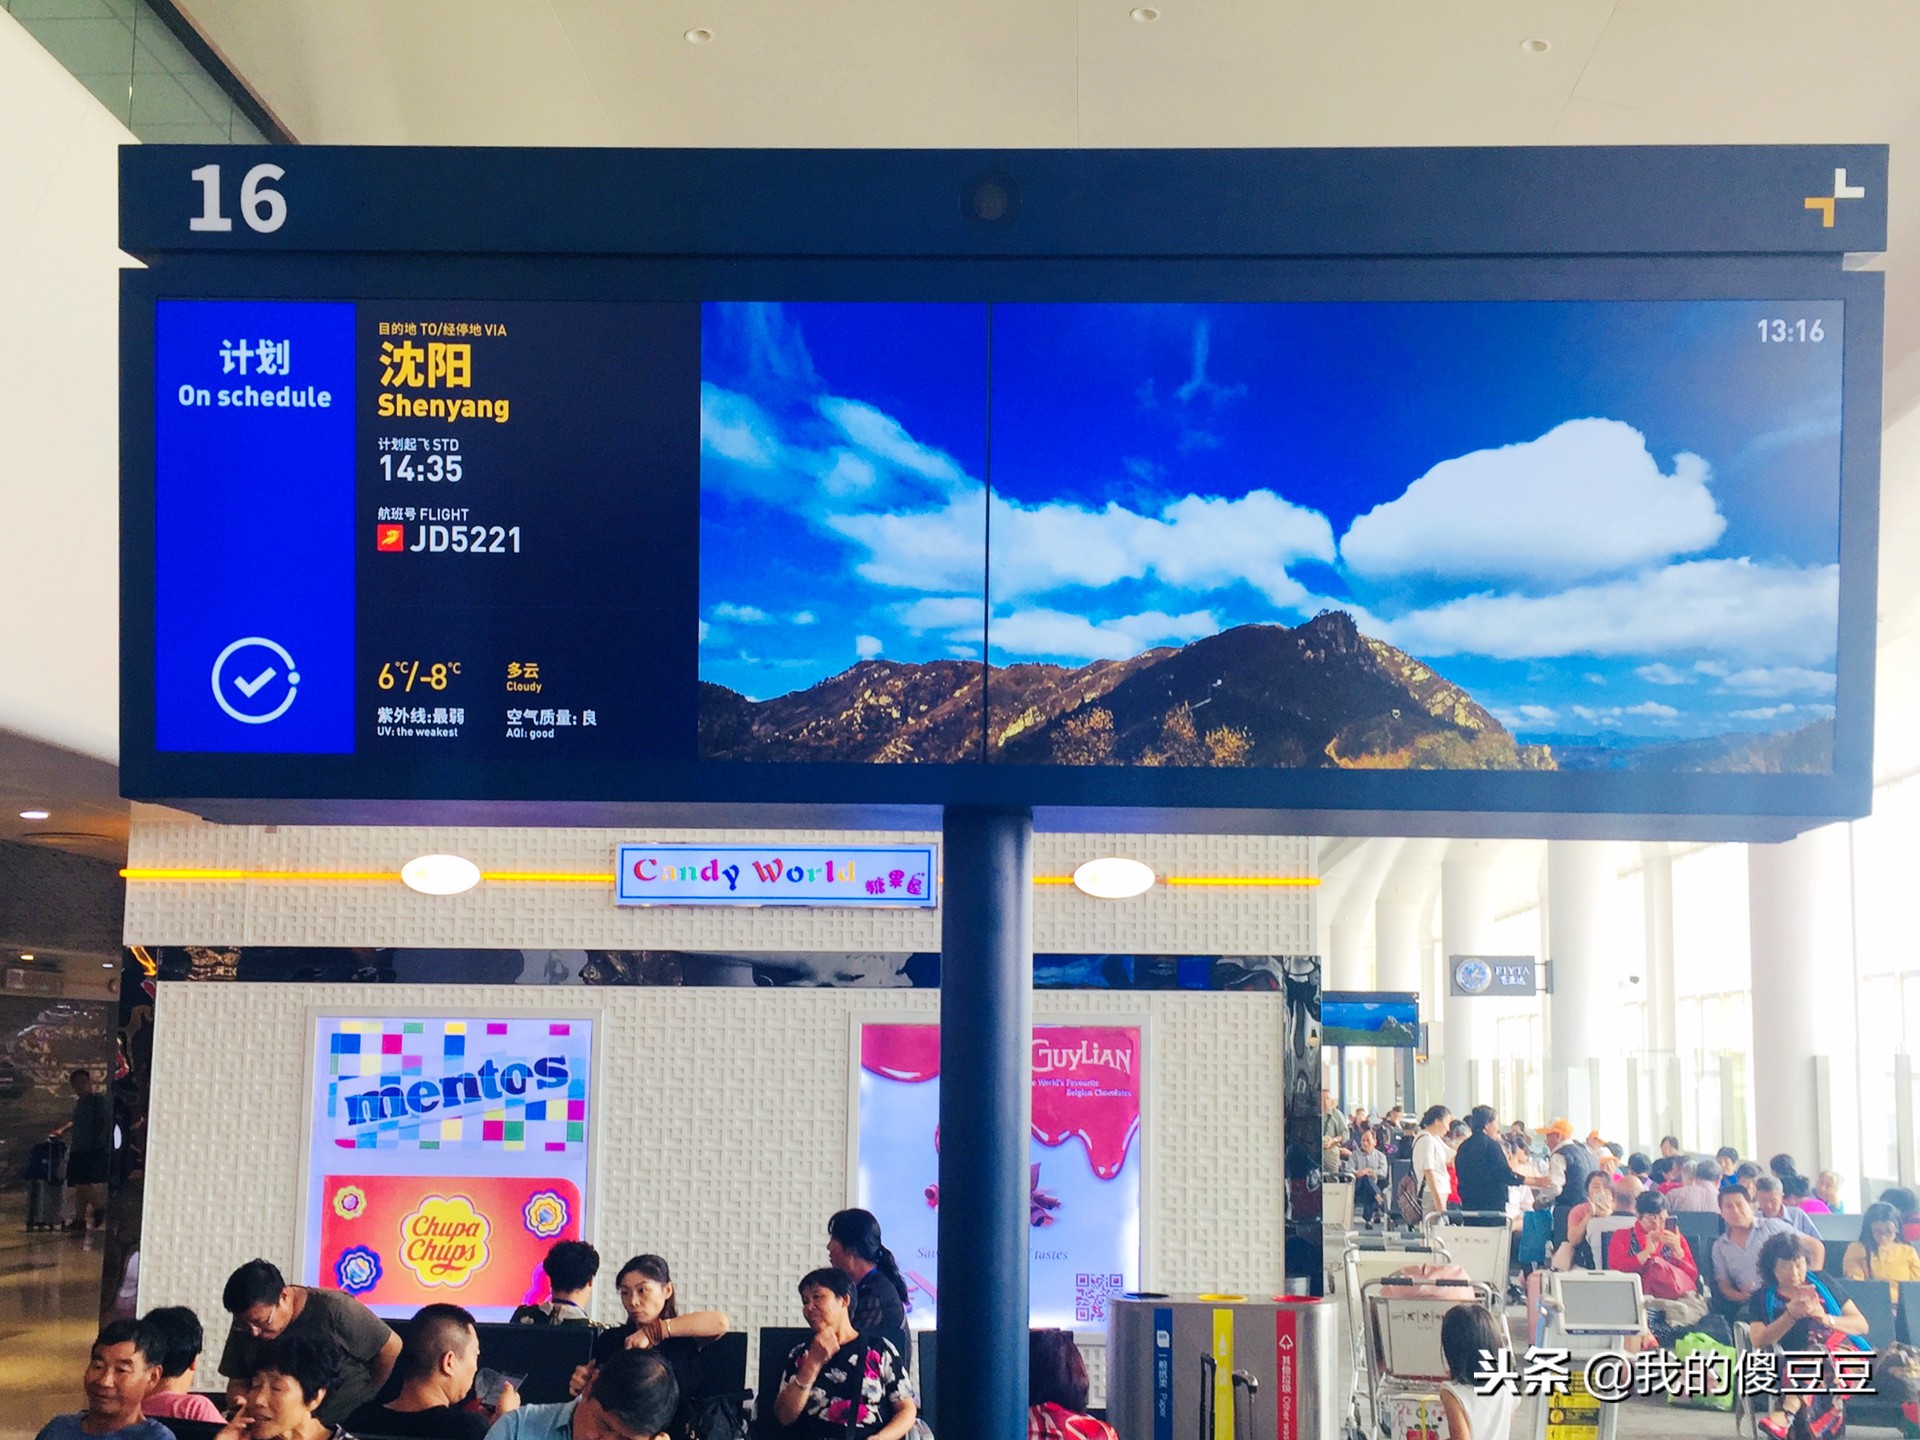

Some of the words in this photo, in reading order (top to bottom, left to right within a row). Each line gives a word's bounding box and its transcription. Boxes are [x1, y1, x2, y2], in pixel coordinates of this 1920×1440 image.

[188, 163, 288, 233] 16
[378, 322, 417, 336] 目的地
[484, 323, 507, 337] VIA
[1757, 318, 1825, 343] 13:16
[219, 338, 290, 376] 计划
[379, 340, 471, 388] 沈阳
[178, 384, 211, 407] On
[217, 385, 332, 408] schedule
[377, 392, 510, 424] Shenyang
[377, 437, 430, 452] 计划起飞
[432, 438, 460, 452] STD
[379, 454, 463, 482] 14:35
[377, 506, 417, 521] 航班号
[419, 508, 470, 522] FLIGHT
[409, 525, 521, 553] JD5221
[507, 662, 540, 679] 多云
[506, 681, 543, 693] Cloudy
[582, 710, 598, 726] 良
[377, 727, 395, 737] UV:
[397, 727, 414, 737] the
[415, 727, 458, 738] weakest
[506, 728, 528, 738] AQI:
[529, 729, 555, 740] good
[633, 859, 740, 891] Candy
[752, 858, 856, 883] World
[344, 1055, 569, 1126] mentos
[1038, 1078, 1065, 1087] World's
[1066, 1078, 1100, 1087] Favourite
[1066, 1088, 1093, 1097] Belgian
[1094, 1088, 1132, 1097] Chocolates
[412, 1216, 480, 1248] Chupa
[407, 1239, 476, 1275] Chups
[1034, 1248, 1068, 1260] tastes
[1158, 1392, 1168, 1418] Paper
[1282, 1396, 1292, 1422] Other
